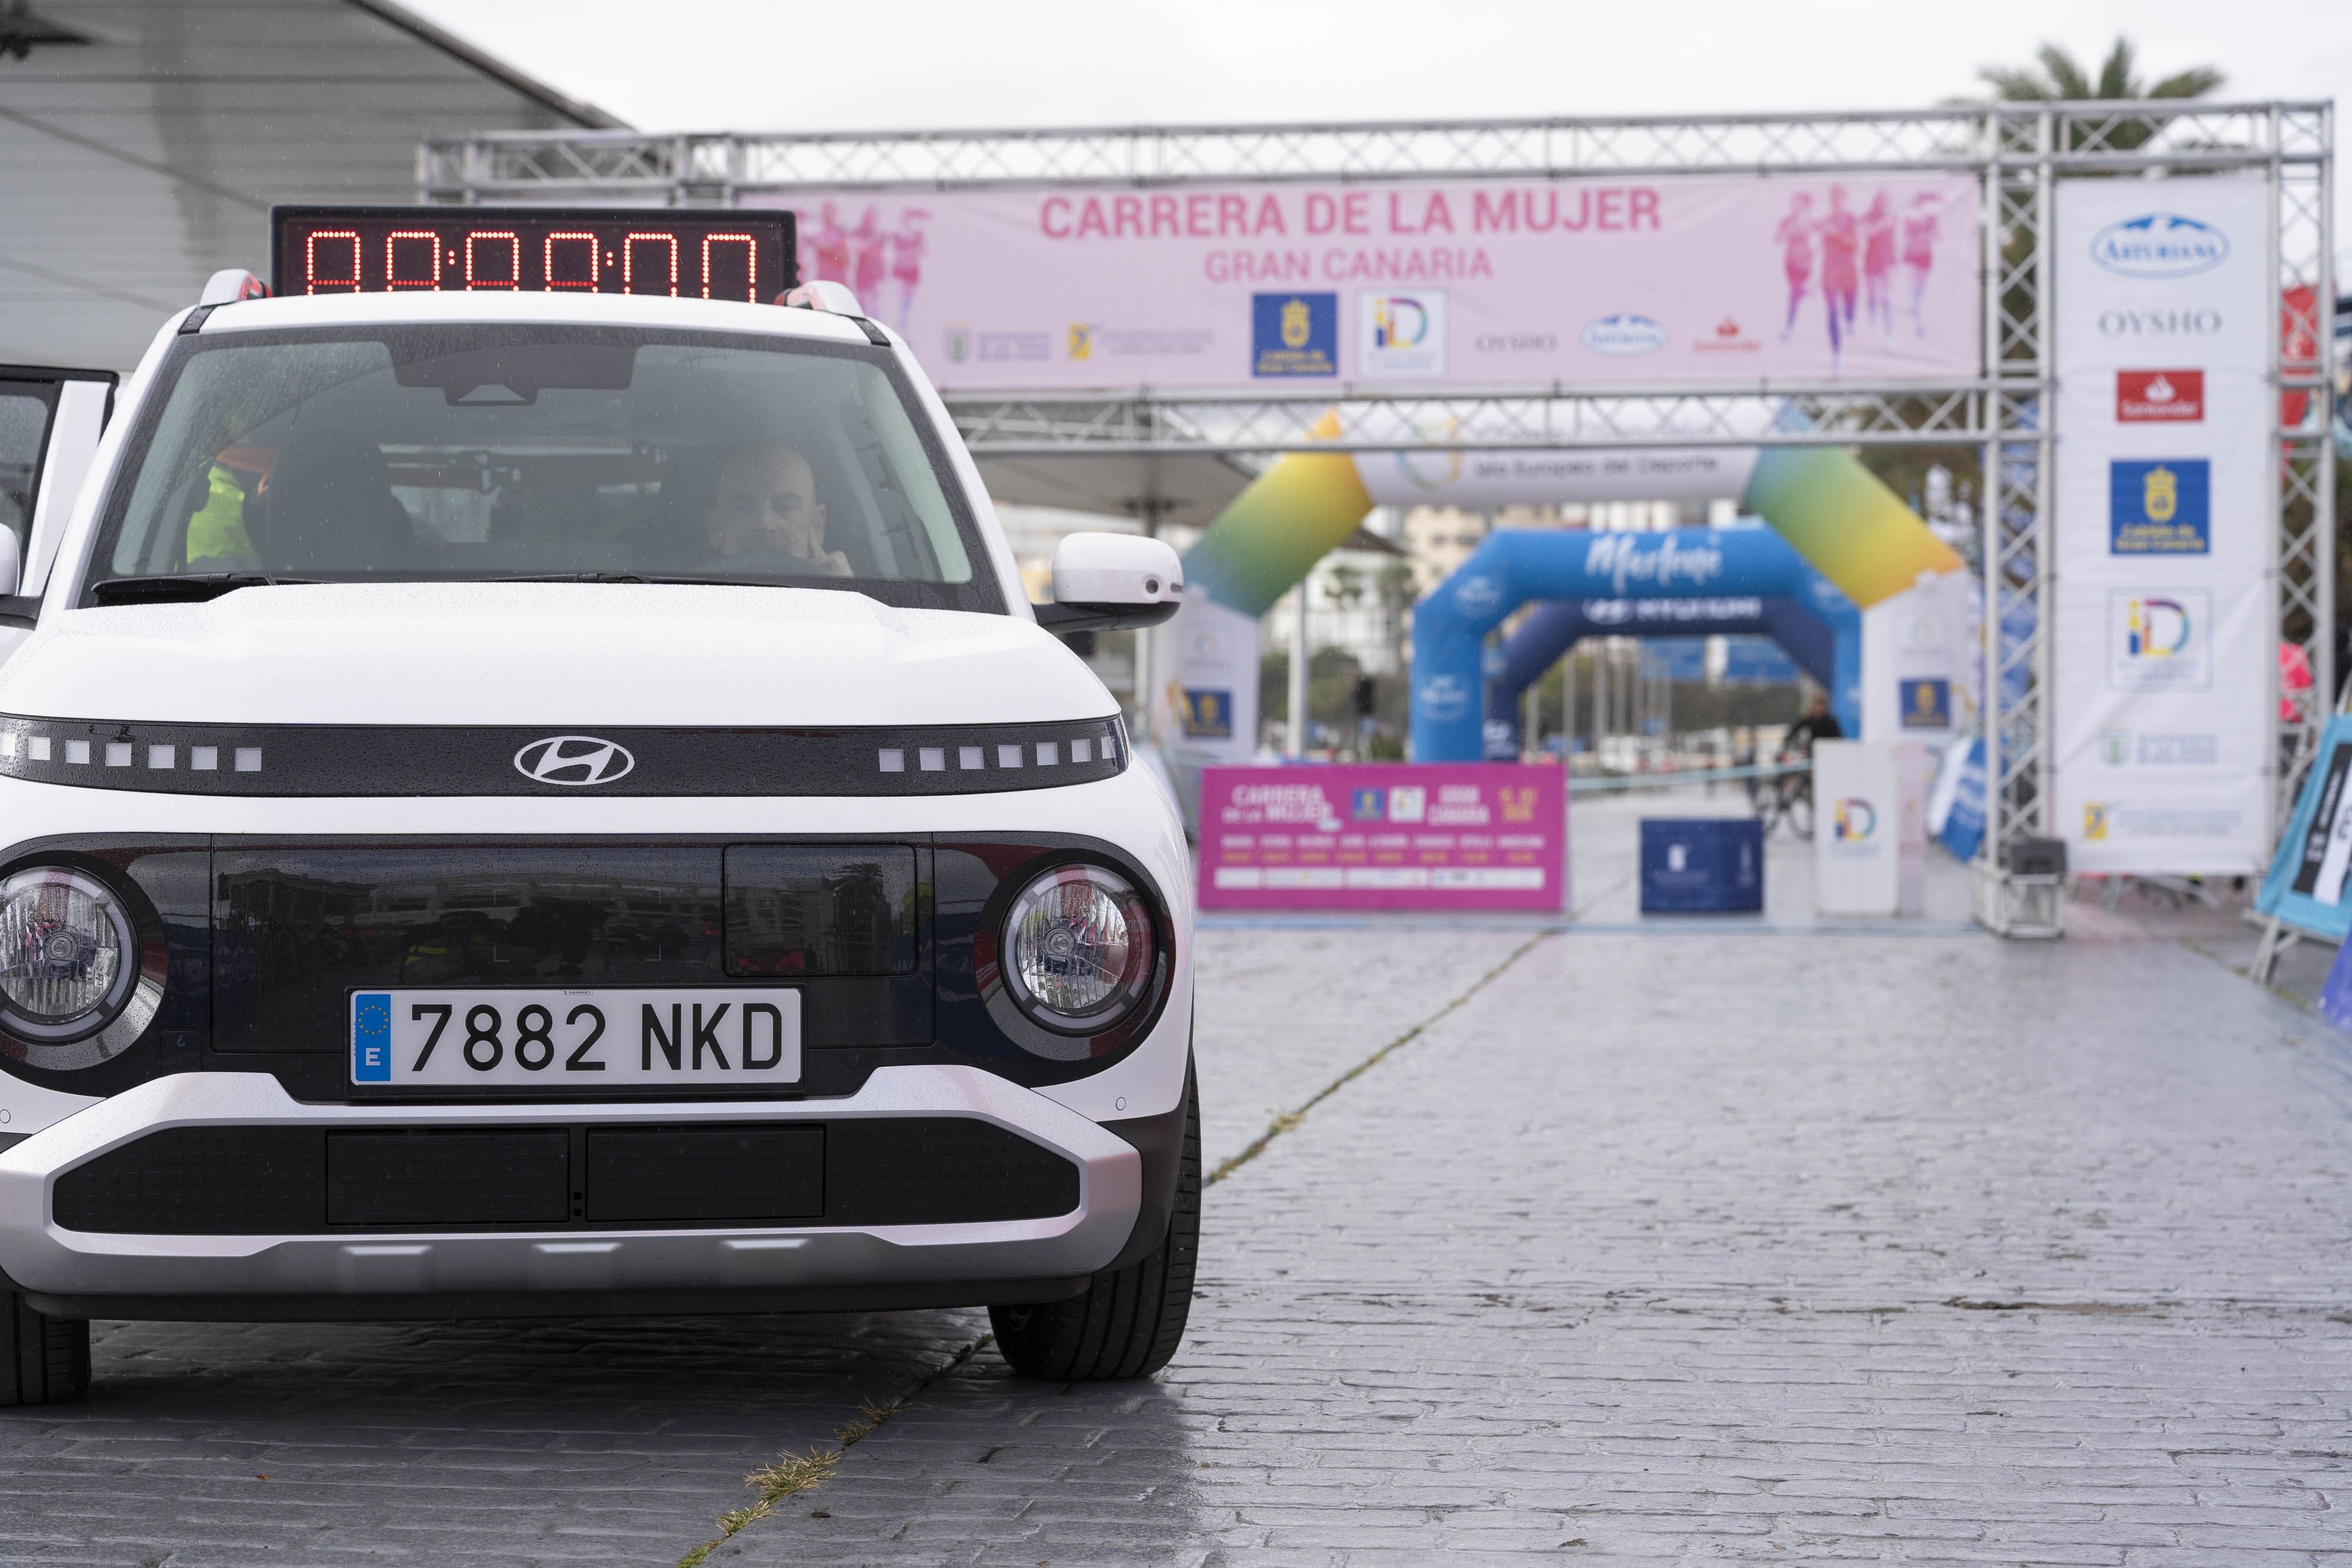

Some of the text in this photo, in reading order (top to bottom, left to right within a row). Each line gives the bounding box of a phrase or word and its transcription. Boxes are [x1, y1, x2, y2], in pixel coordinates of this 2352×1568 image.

[1041, 188, 1661, 239] CARRERA DE LA MUJER
[1205, 247, 1492, 283] GRAN CANARIA
[2098, 309, 2223, 336] OYSHO
[412, 1004, 606, 1072] 7882
[642, 1002, 782, 1071] NKD
[365, 1047, 380, 1066] E
